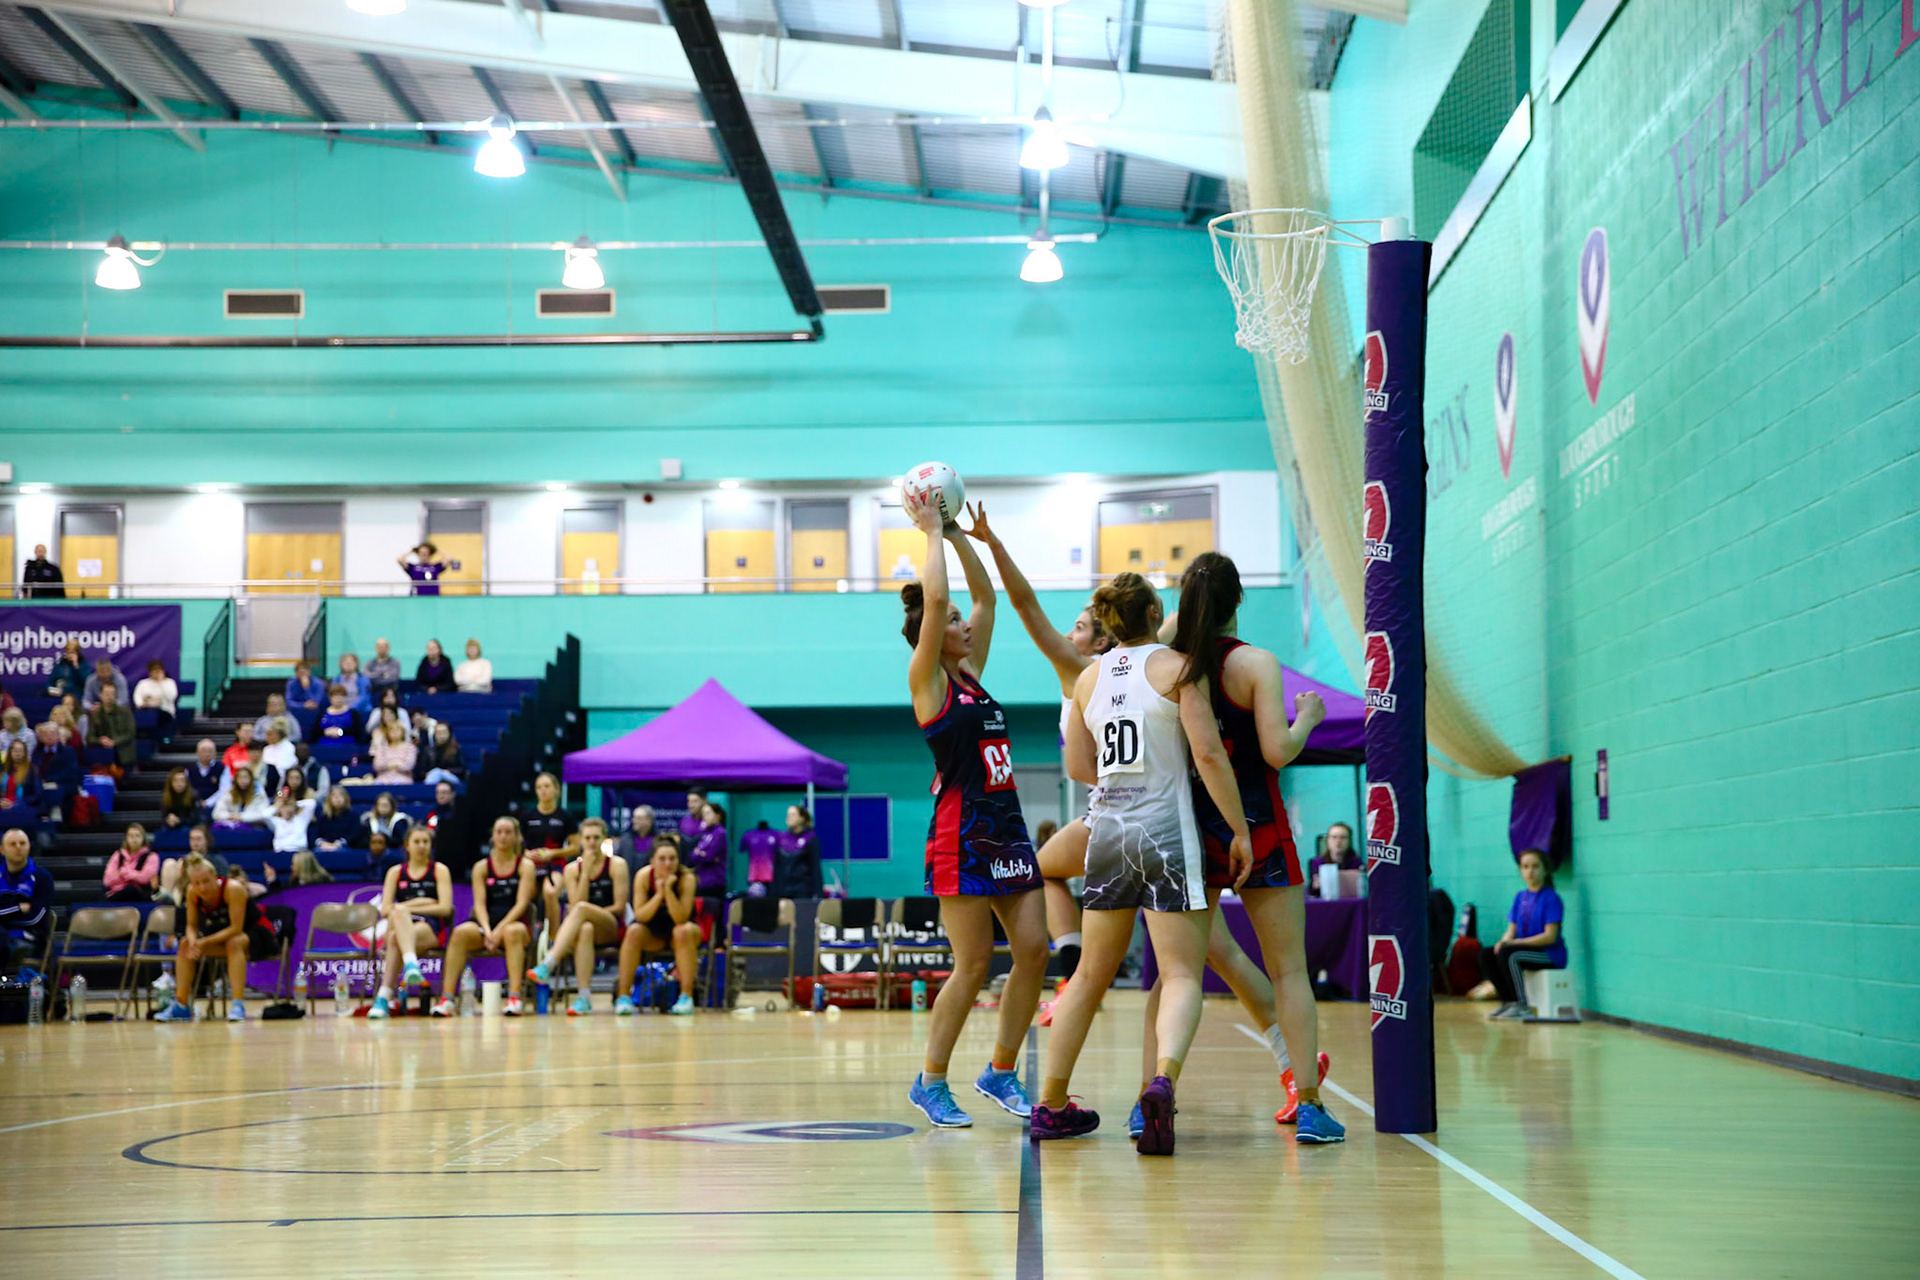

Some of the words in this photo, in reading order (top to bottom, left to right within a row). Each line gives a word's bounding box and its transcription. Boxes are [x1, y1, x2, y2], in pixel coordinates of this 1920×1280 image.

[1668, 0, 1874, 260] WHERE
[1112, 693, 1126, 707] MAY
[990, 857, 1033, 881] Vitality
